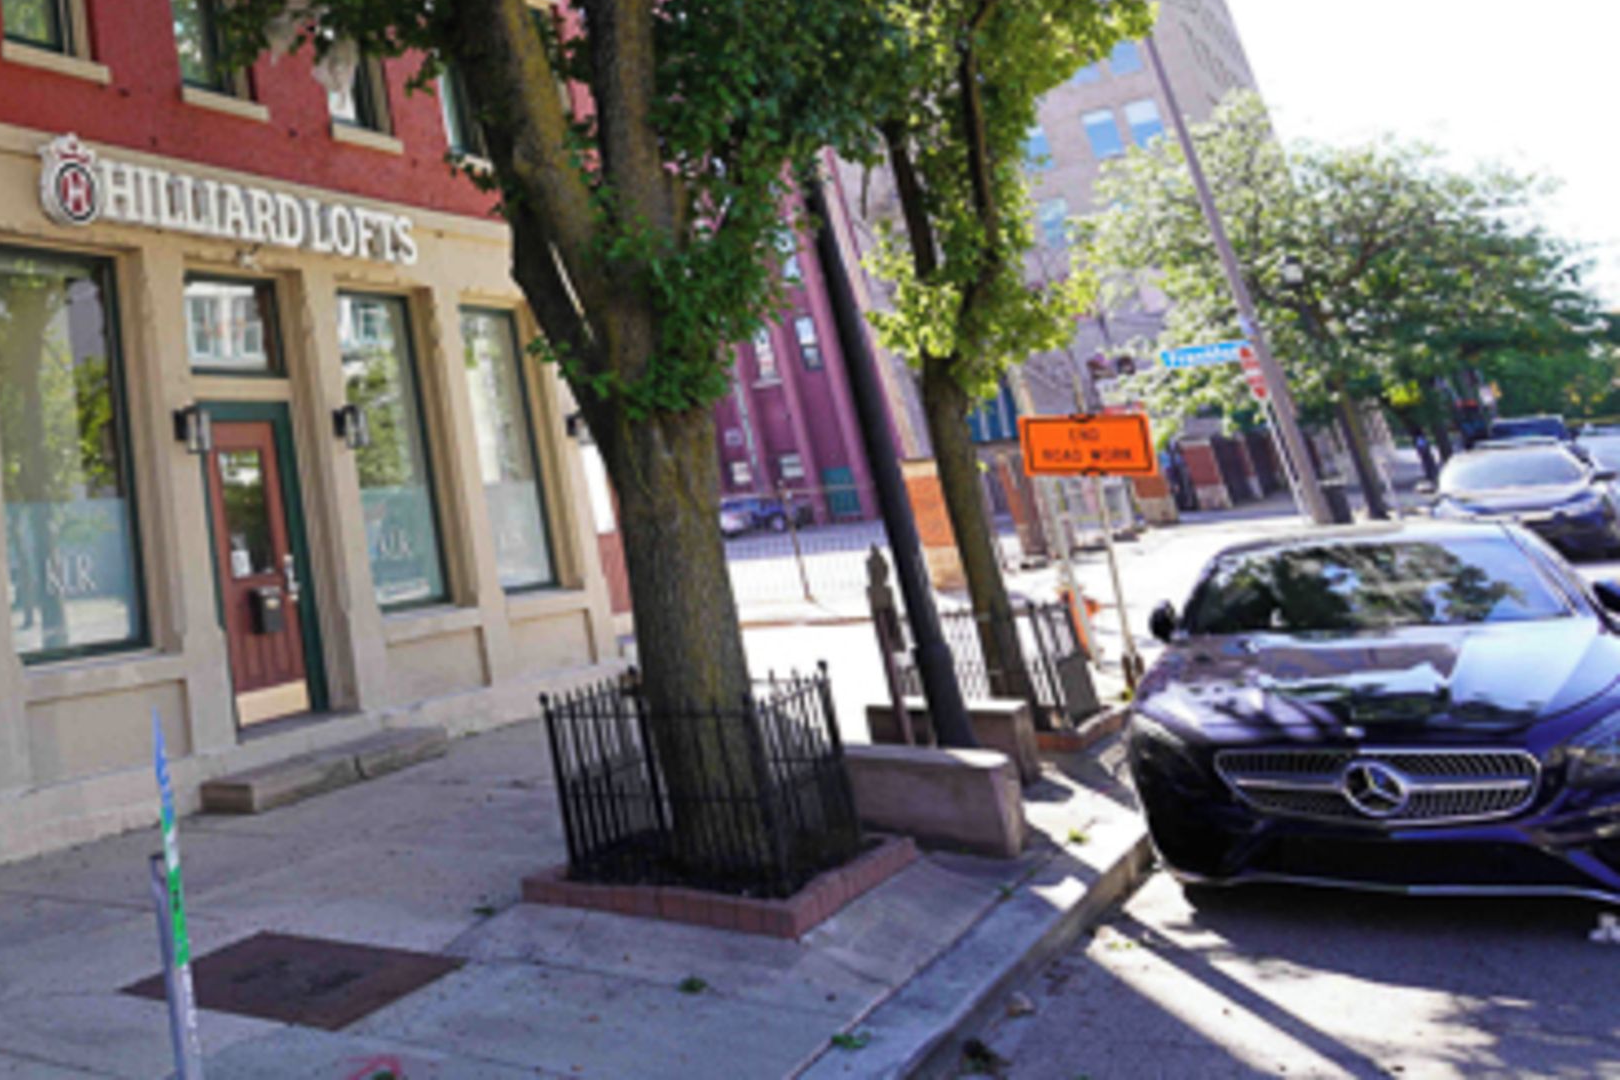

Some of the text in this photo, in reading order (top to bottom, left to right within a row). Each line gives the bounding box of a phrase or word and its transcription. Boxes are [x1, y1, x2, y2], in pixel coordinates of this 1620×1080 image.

[98, 158, 418, 265] HILLIARD LOFTS
[1069, 427, 1100, 441] END
[1042, 448, 1132, 463] ROAD WORK
